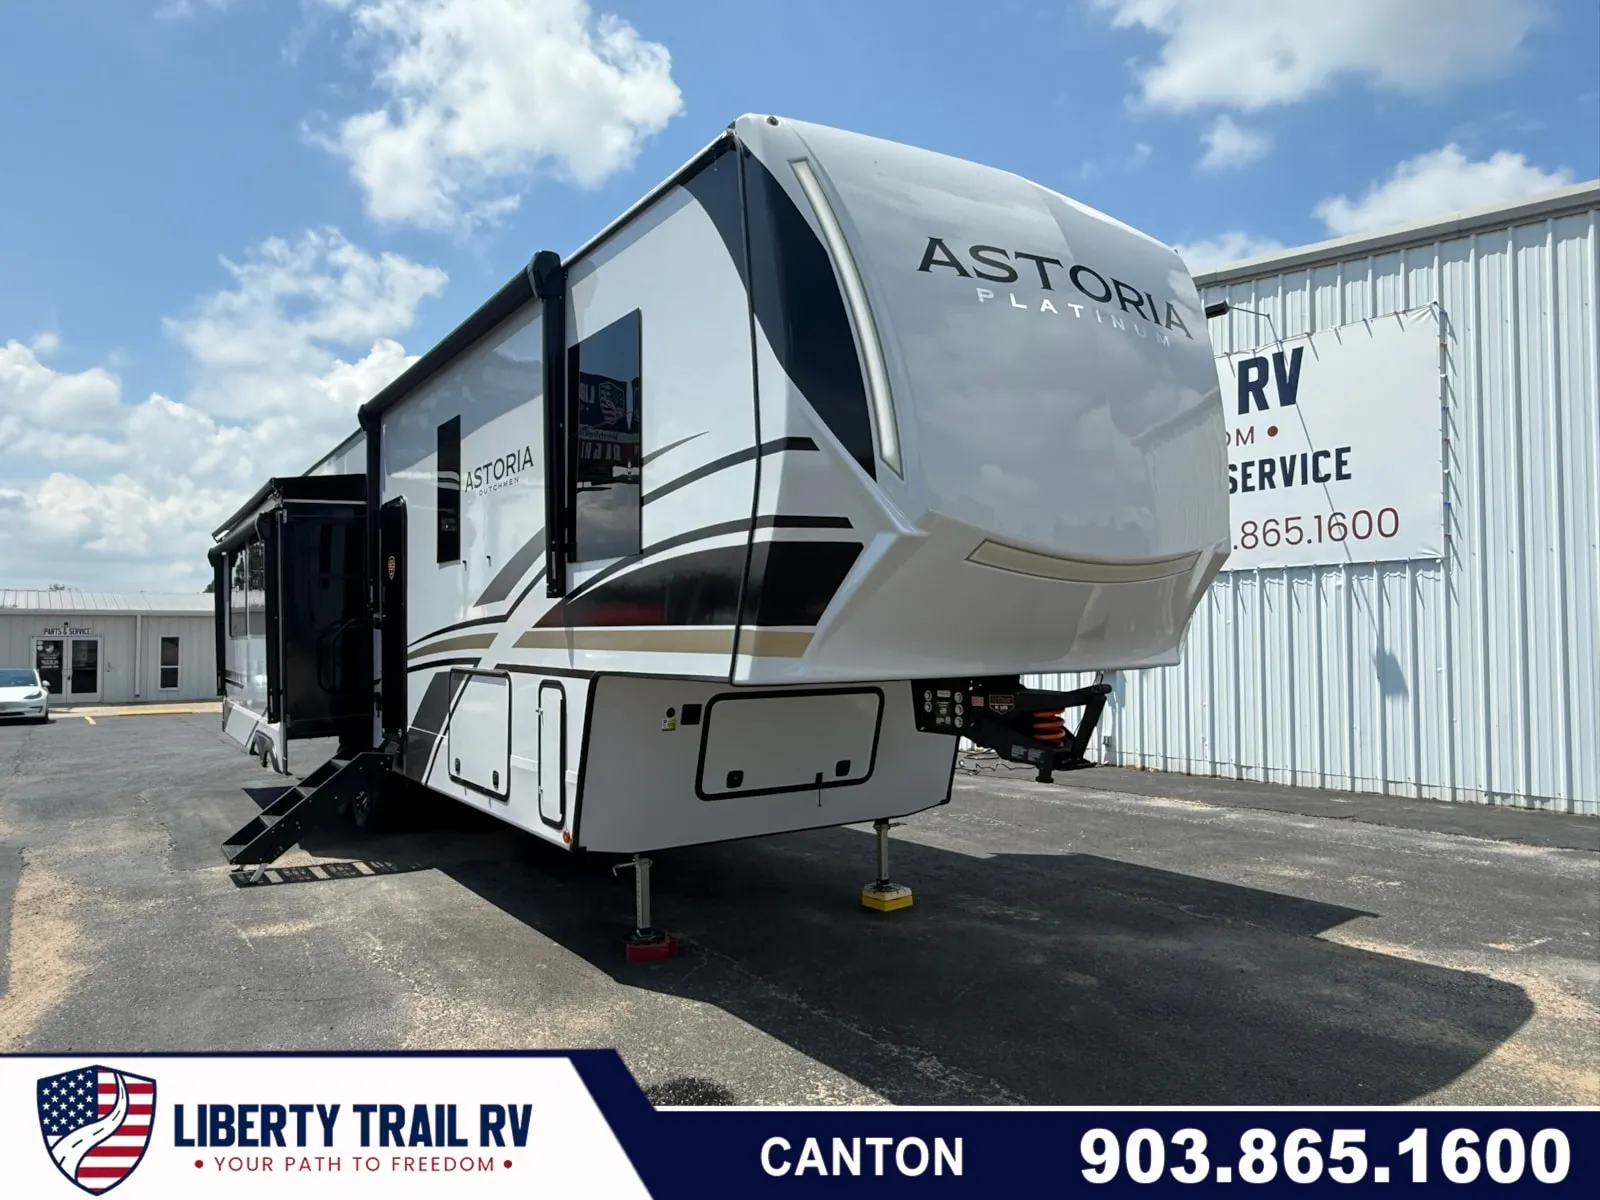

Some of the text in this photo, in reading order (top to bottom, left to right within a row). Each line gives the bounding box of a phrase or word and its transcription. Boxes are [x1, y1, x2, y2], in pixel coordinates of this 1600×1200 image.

[917, 236, 1194, 341] ASTORIA
[975, 287, 1171, 348] PLATINUM
[1237, 346, 1304, 415] RV
[464, 445, 534, 493] ASTORIA
[478, 476, 519, 497] DUTCHMEN
[1228, 446, 1352, 495] SERVICE
